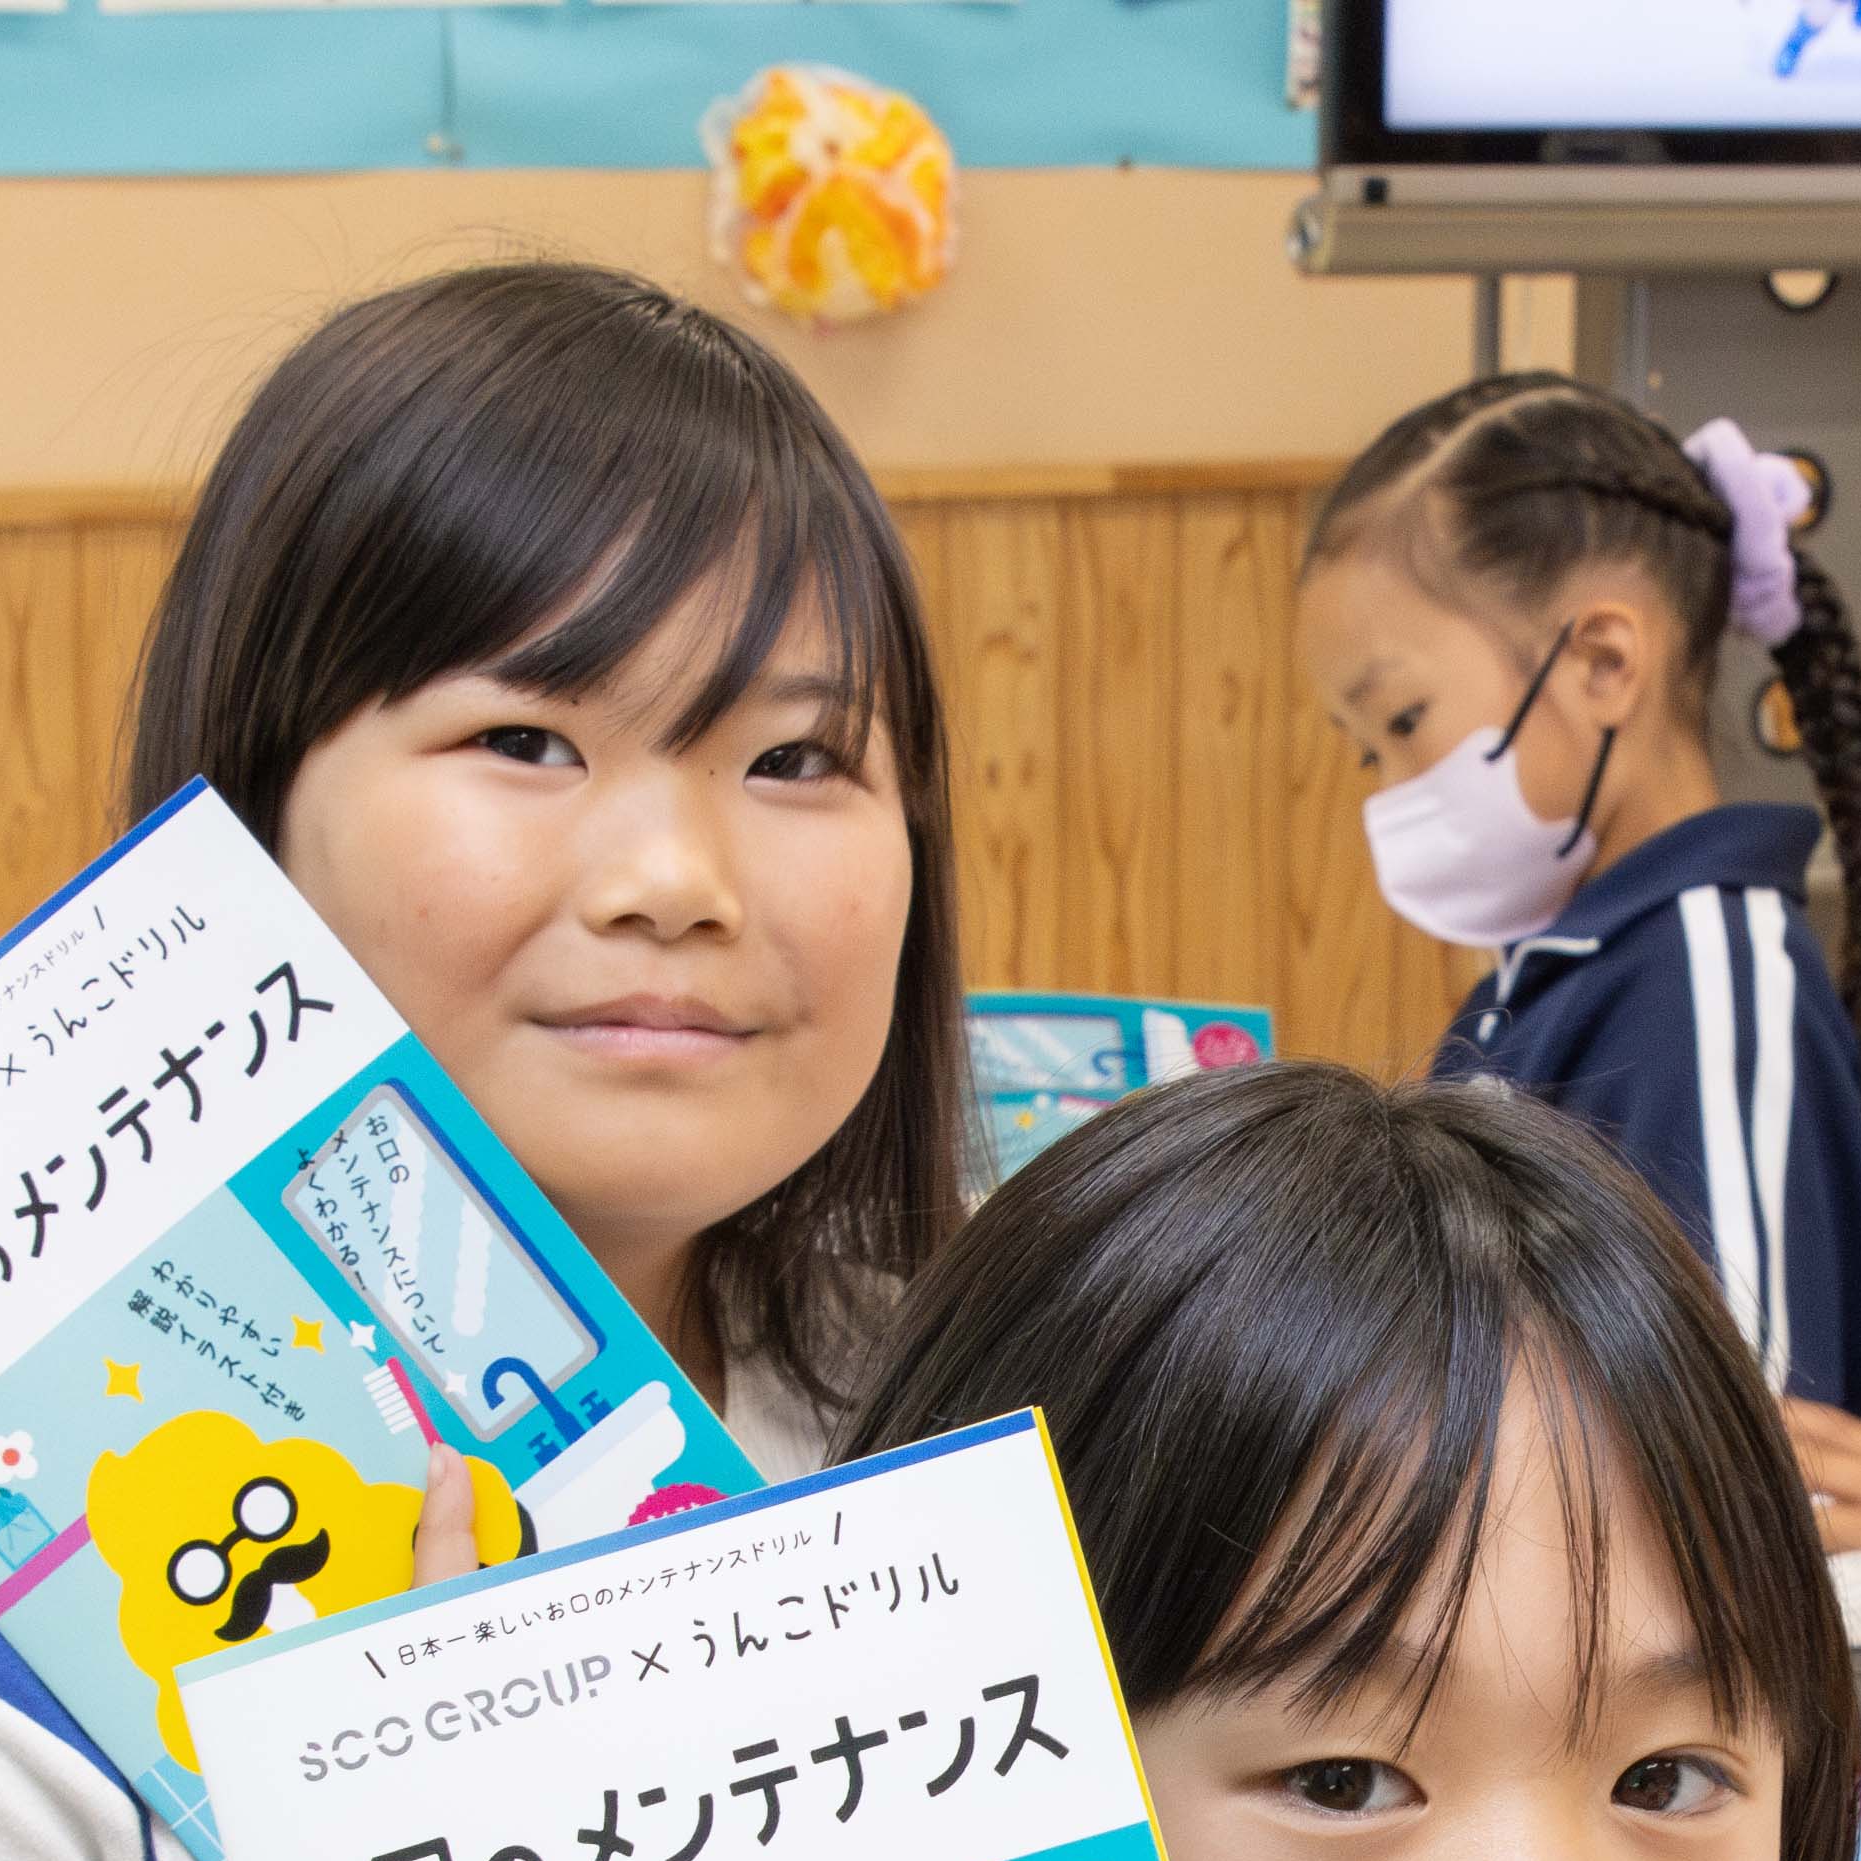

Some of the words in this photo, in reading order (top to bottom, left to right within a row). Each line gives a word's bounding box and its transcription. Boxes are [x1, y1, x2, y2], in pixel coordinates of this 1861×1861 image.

[27, 905, 206, 1057] うんこドリル
[296, 1147, 368, 1292] よくわかる！
[367, 1115, 410, 1185] お口の
[152, 1260, 282, 1357] わかりやすい
[333, 1129, 446, 1355] メンテナンスについて
[127, 1287, 306, 1423] 解説イラスト付き
[299, 1717, 414, 1783] SCO
[425, 1655, 611, 1741] GROUP
[693, 1552, 959, 1669] うんこドリル
[398, 1529, 812, 1666] 日本一楽しいお口のメンテナンスドリル
